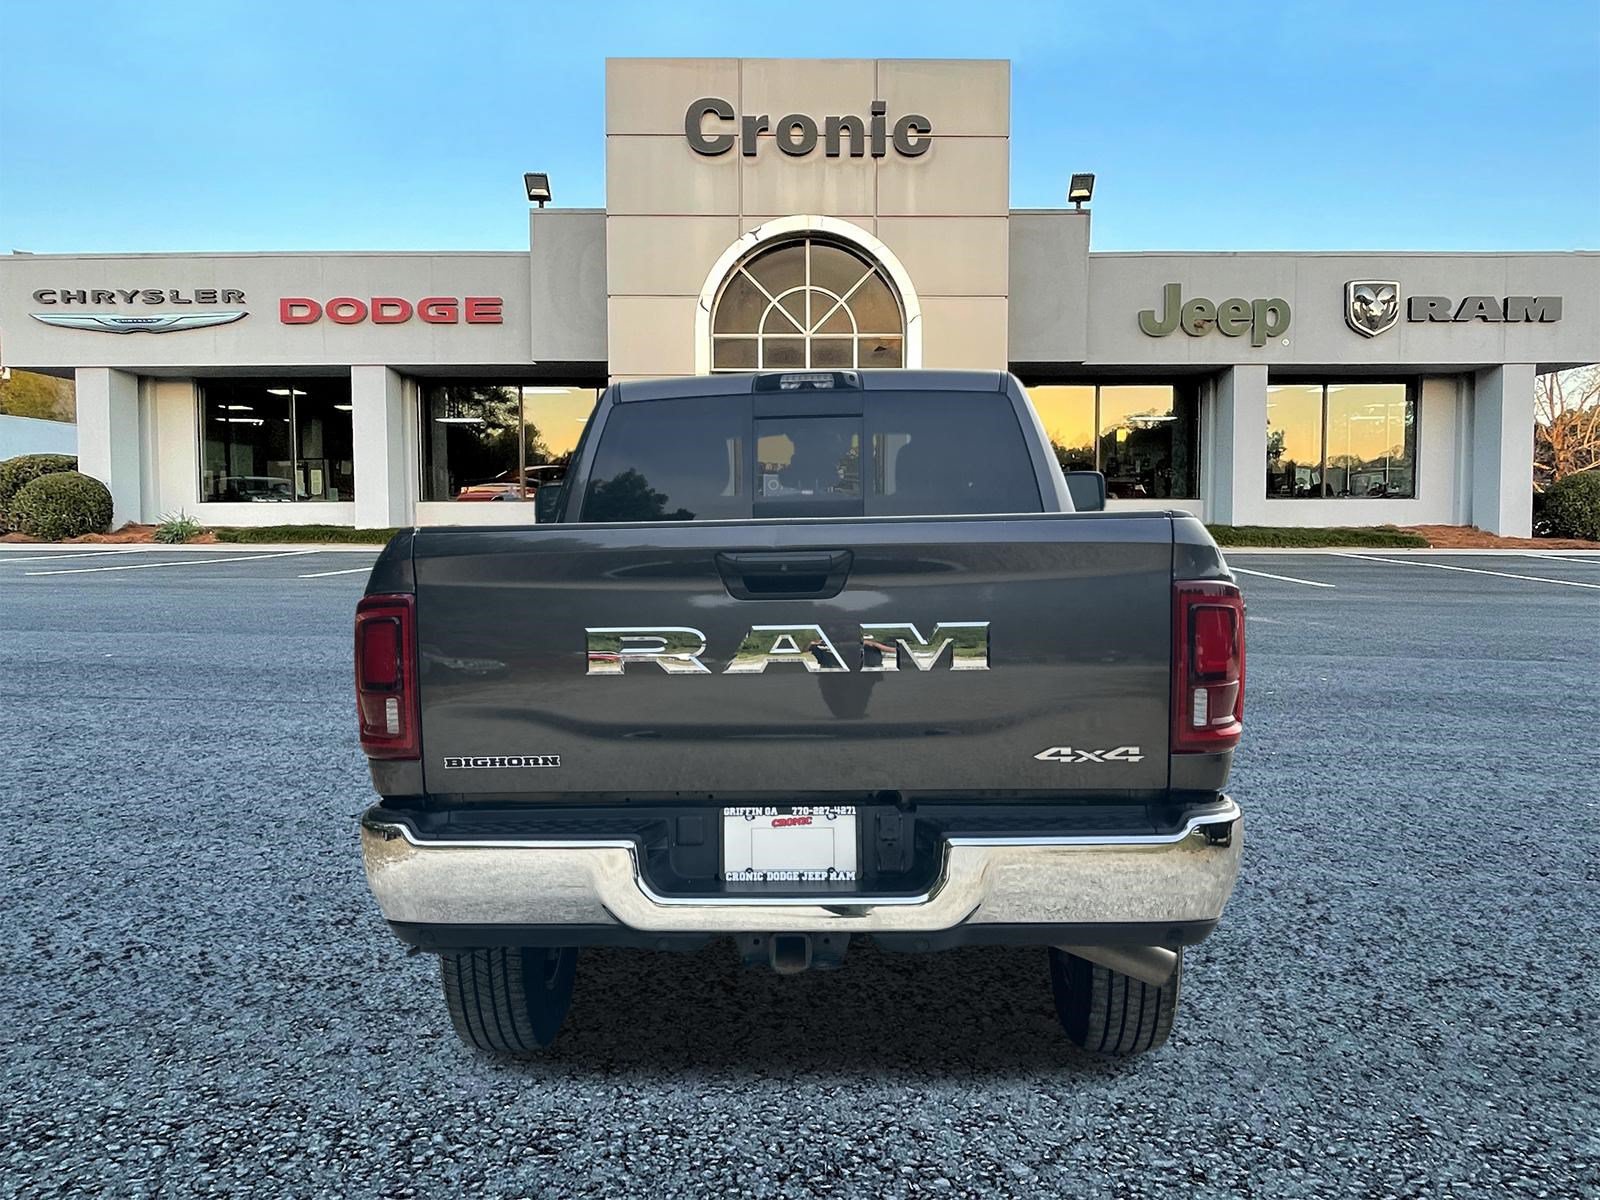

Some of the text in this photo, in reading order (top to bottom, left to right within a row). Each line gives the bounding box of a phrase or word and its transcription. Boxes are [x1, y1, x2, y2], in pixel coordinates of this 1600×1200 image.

[685, 97, 932, 158] Cronic
[32, 288, 246, 304] CHRYSLER
[1408, 296, 1563, 322] RAM
[280, 296, 504, 325] DODGE
[1138, 283, 1291, 347] Jeep
[585, 621, 991, 676] RAM
[444, 755, 560, 768] BIGHORN
[724, 806, 856, 816] GRIFFIN GA 770-227-4271
[726, 871, 856, 881] CRONIC DODGE JEEP RAM
